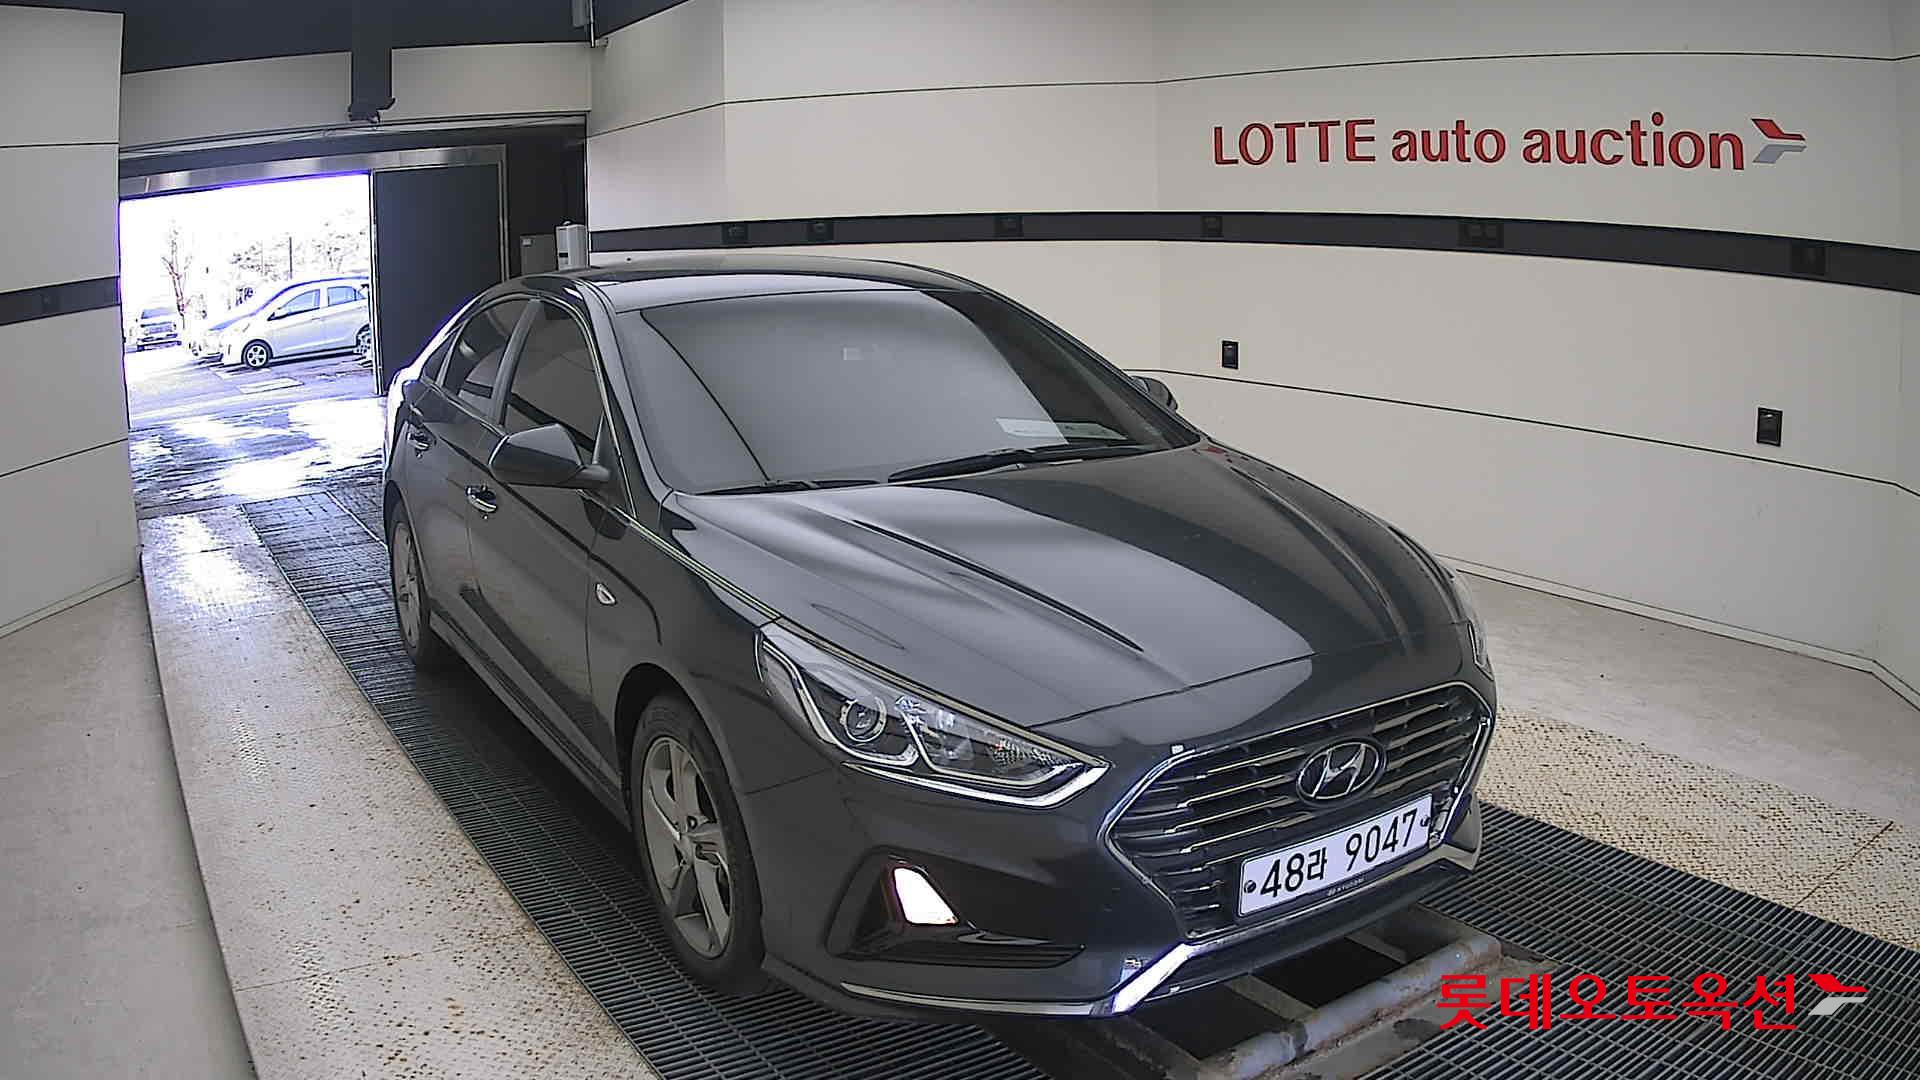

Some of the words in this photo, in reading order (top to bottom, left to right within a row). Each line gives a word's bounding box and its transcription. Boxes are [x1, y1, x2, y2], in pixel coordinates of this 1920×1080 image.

[1214, 120, 1375, 165] LOTTE
[1391, 120, 1507, 163] auto
[1522, 112, 1745, 170] auction
[1260, 846, 1328, 898] 48라
[1345, 808, 1418, 872] 9047
